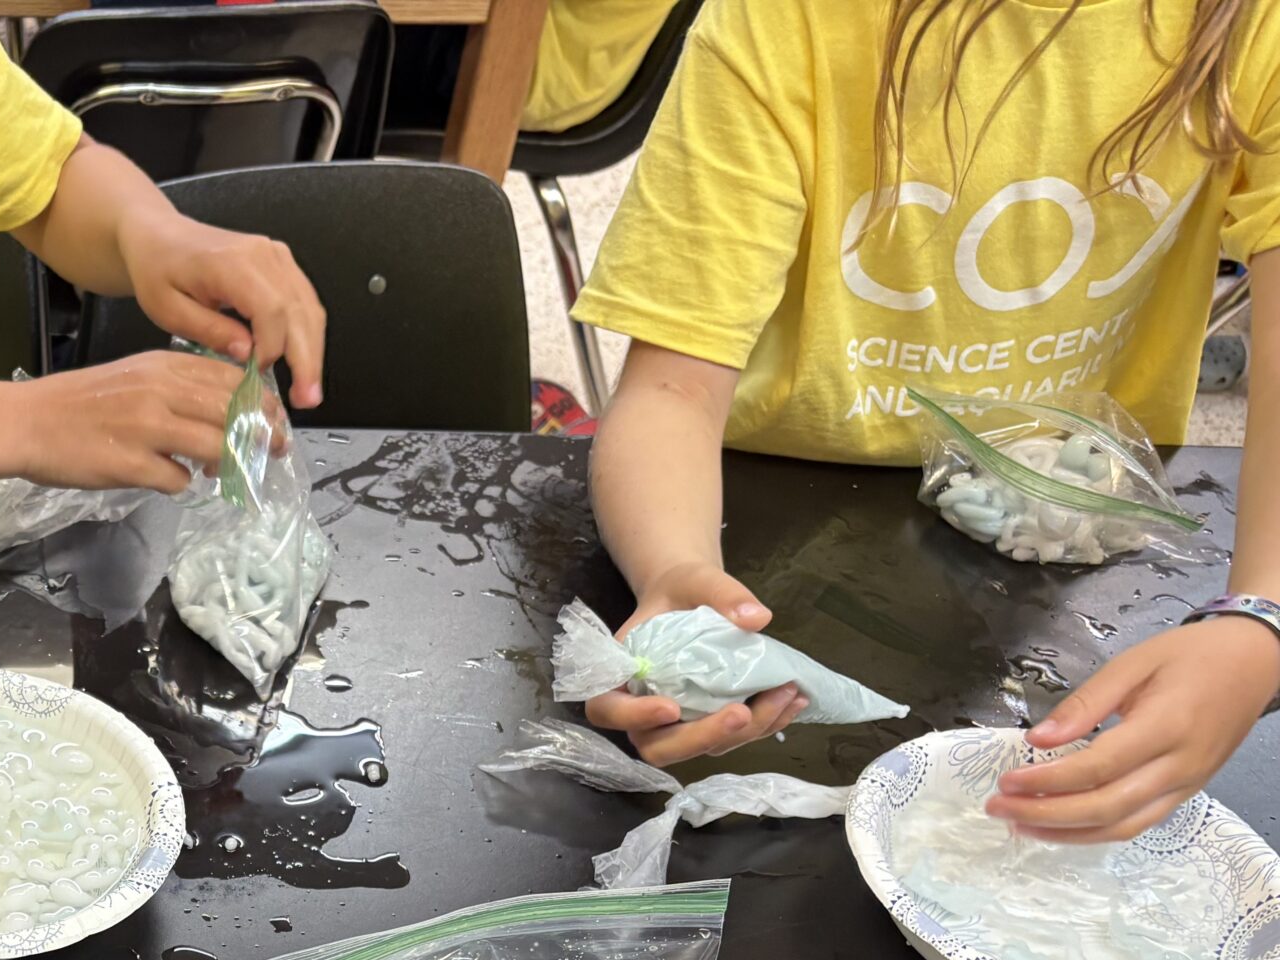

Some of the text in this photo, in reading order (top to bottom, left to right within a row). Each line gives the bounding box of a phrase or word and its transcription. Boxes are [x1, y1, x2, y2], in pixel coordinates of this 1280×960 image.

[846, 308, 1130, 373] SCIENCE CENT
[845, 384, 923, 420] AND
